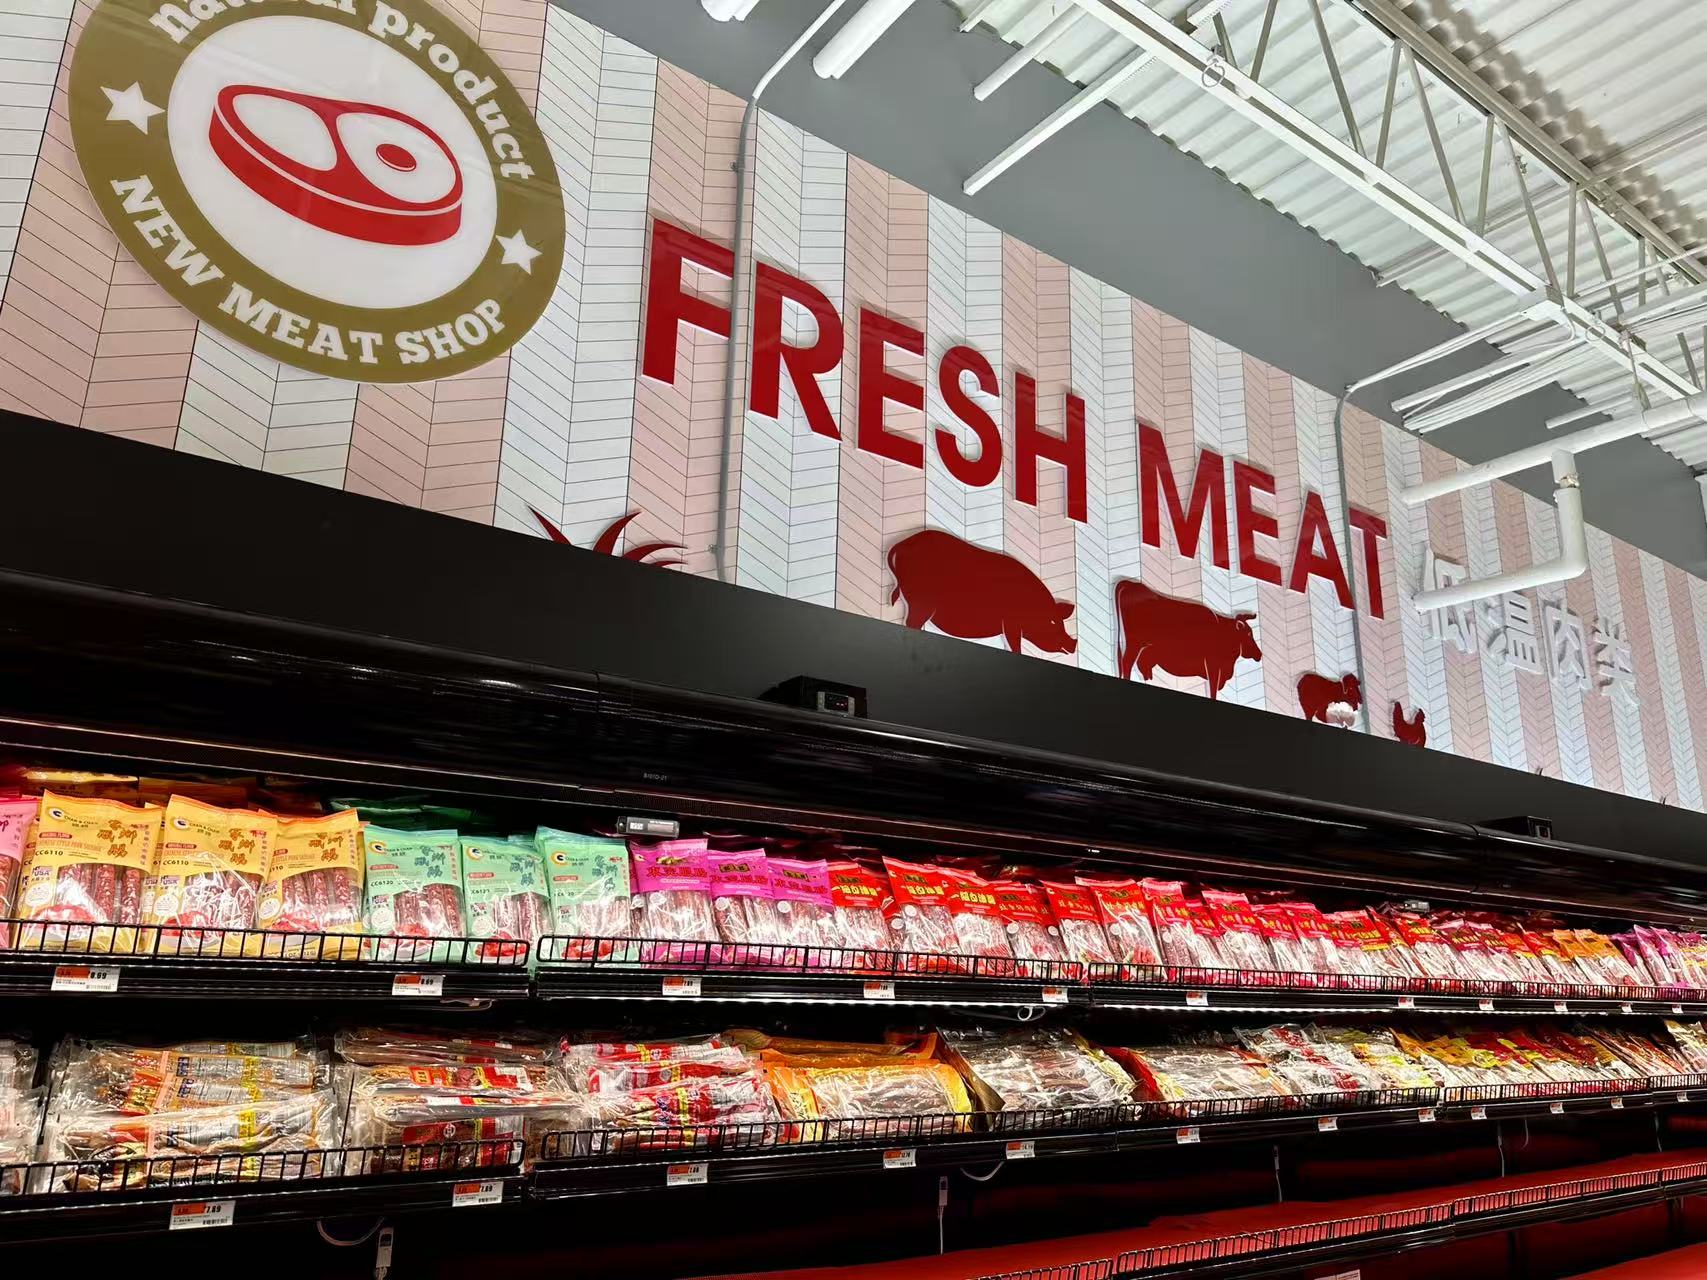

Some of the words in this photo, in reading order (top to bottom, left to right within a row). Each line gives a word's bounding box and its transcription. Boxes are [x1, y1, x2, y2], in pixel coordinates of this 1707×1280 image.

[367, 0, 536, 181] product
[110, 174, 224, 288] NEW
[217, 282, 382, 365] MEAT
[393, 298, 506, 366] SHOP
[642, 218, 1088, 523] FRESH
[1138, 423, 1388, 620] MEAT
